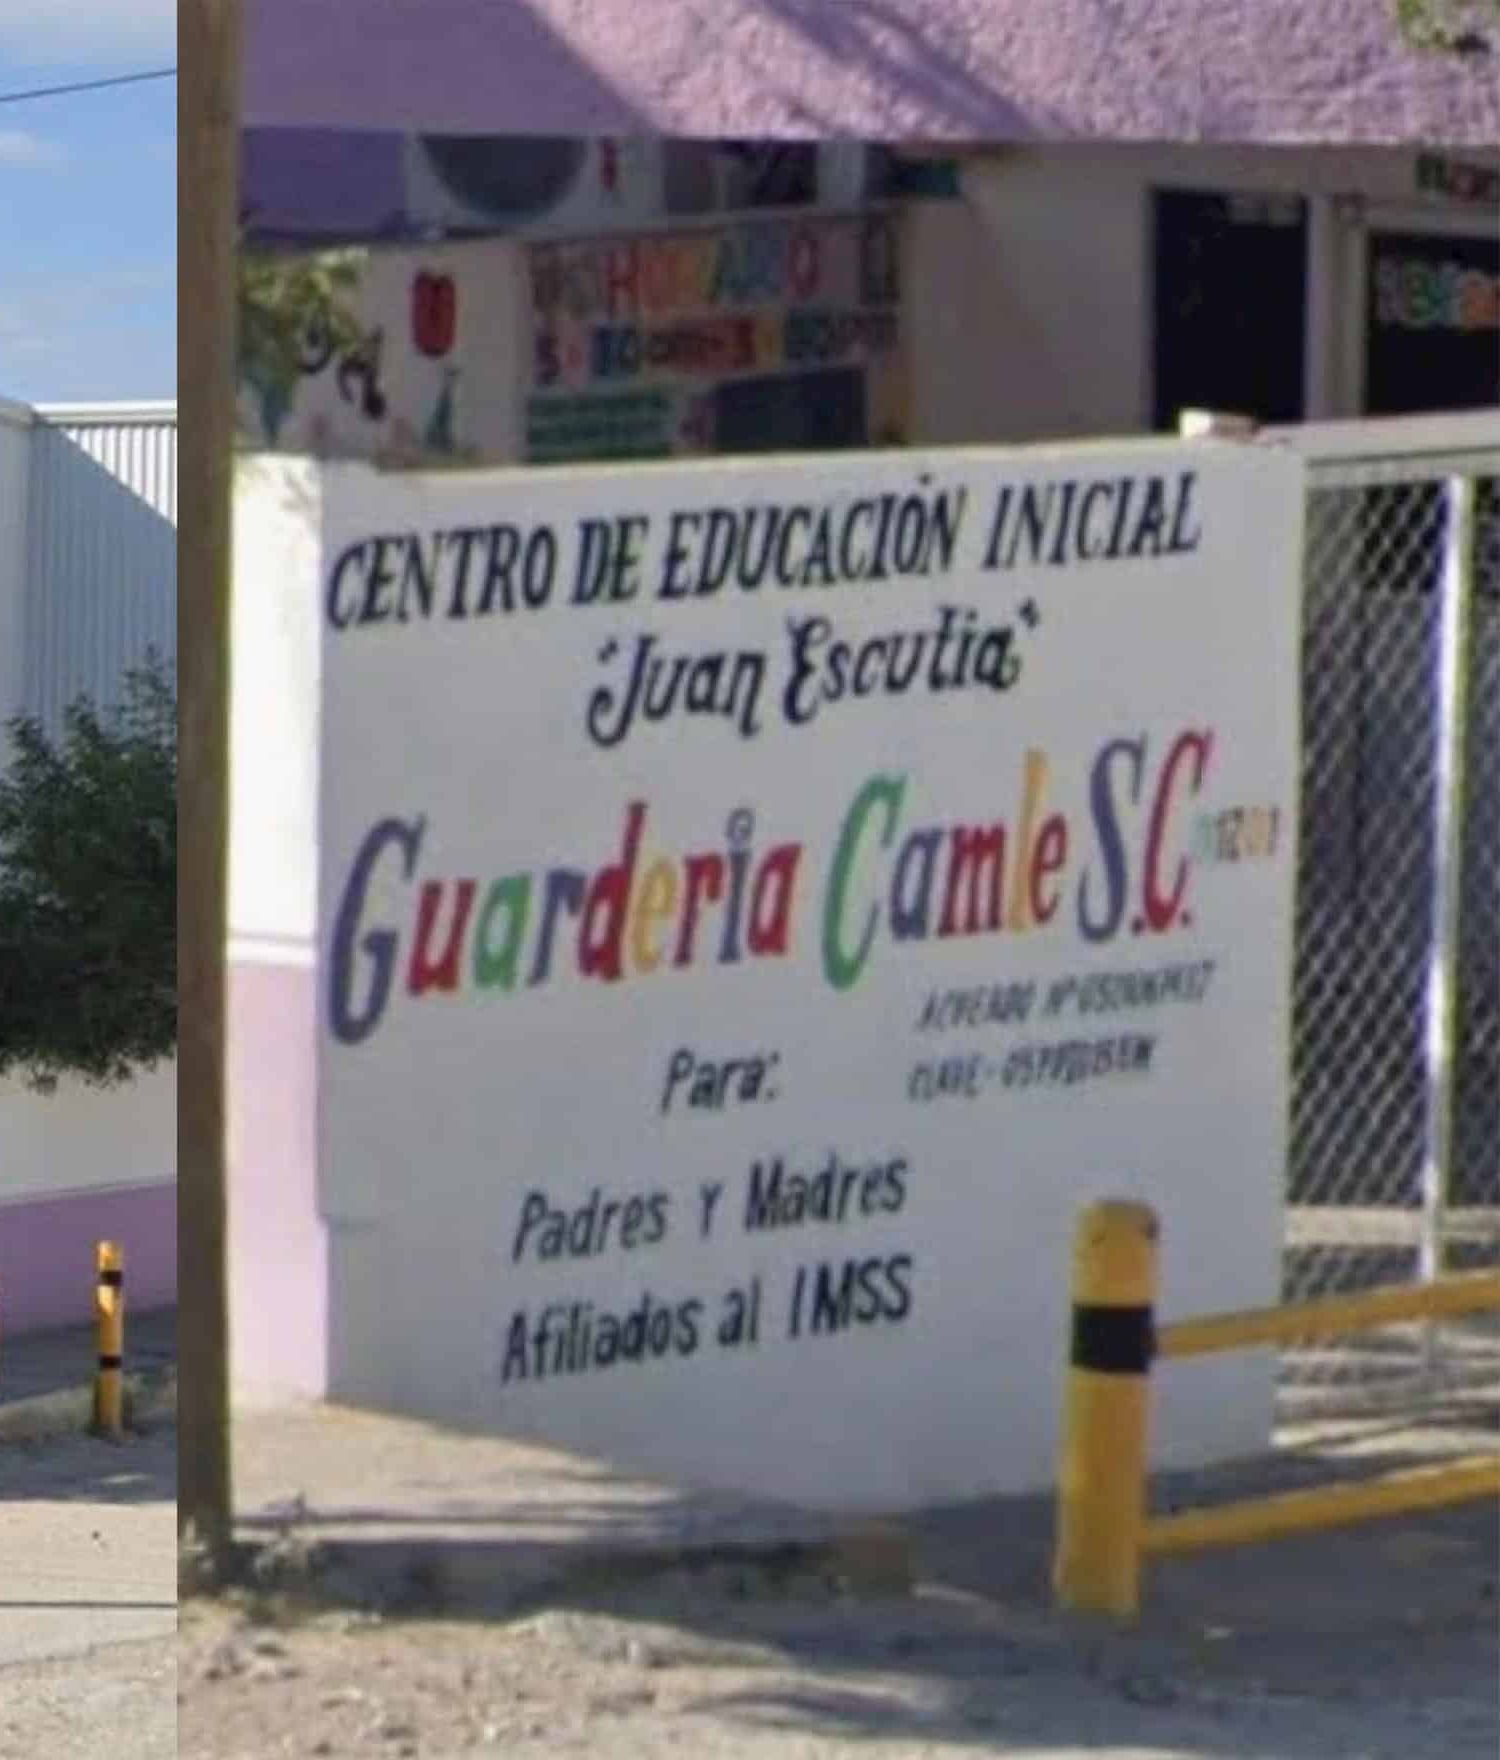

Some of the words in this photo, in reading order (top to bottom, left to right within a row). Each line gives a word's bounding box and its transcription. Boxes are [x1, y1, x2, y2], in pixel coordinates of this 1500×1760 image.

[326, 524, 556, 631] CENTRO
[572, 514, 649, 605] DE
[659, 474, 966, 600] EDUCACIÓN
[984, 471, 1200, 569] INICIAL
[329, 801, 802, 1045] Guarderia
[822, 750, 1068, 991] Camle
[1077, 729, 1213, 943] S.C.
[660, 1049, 780, 1113] Para:
[512, 1188, 668, 1264] Padres
[744, 1149, 908, 1231] Madres
[500, 1292, 701, 1384] Afiliados
[717, 1270, 762, 1345] al
[788, 1254, 912, 1338] IMSS
